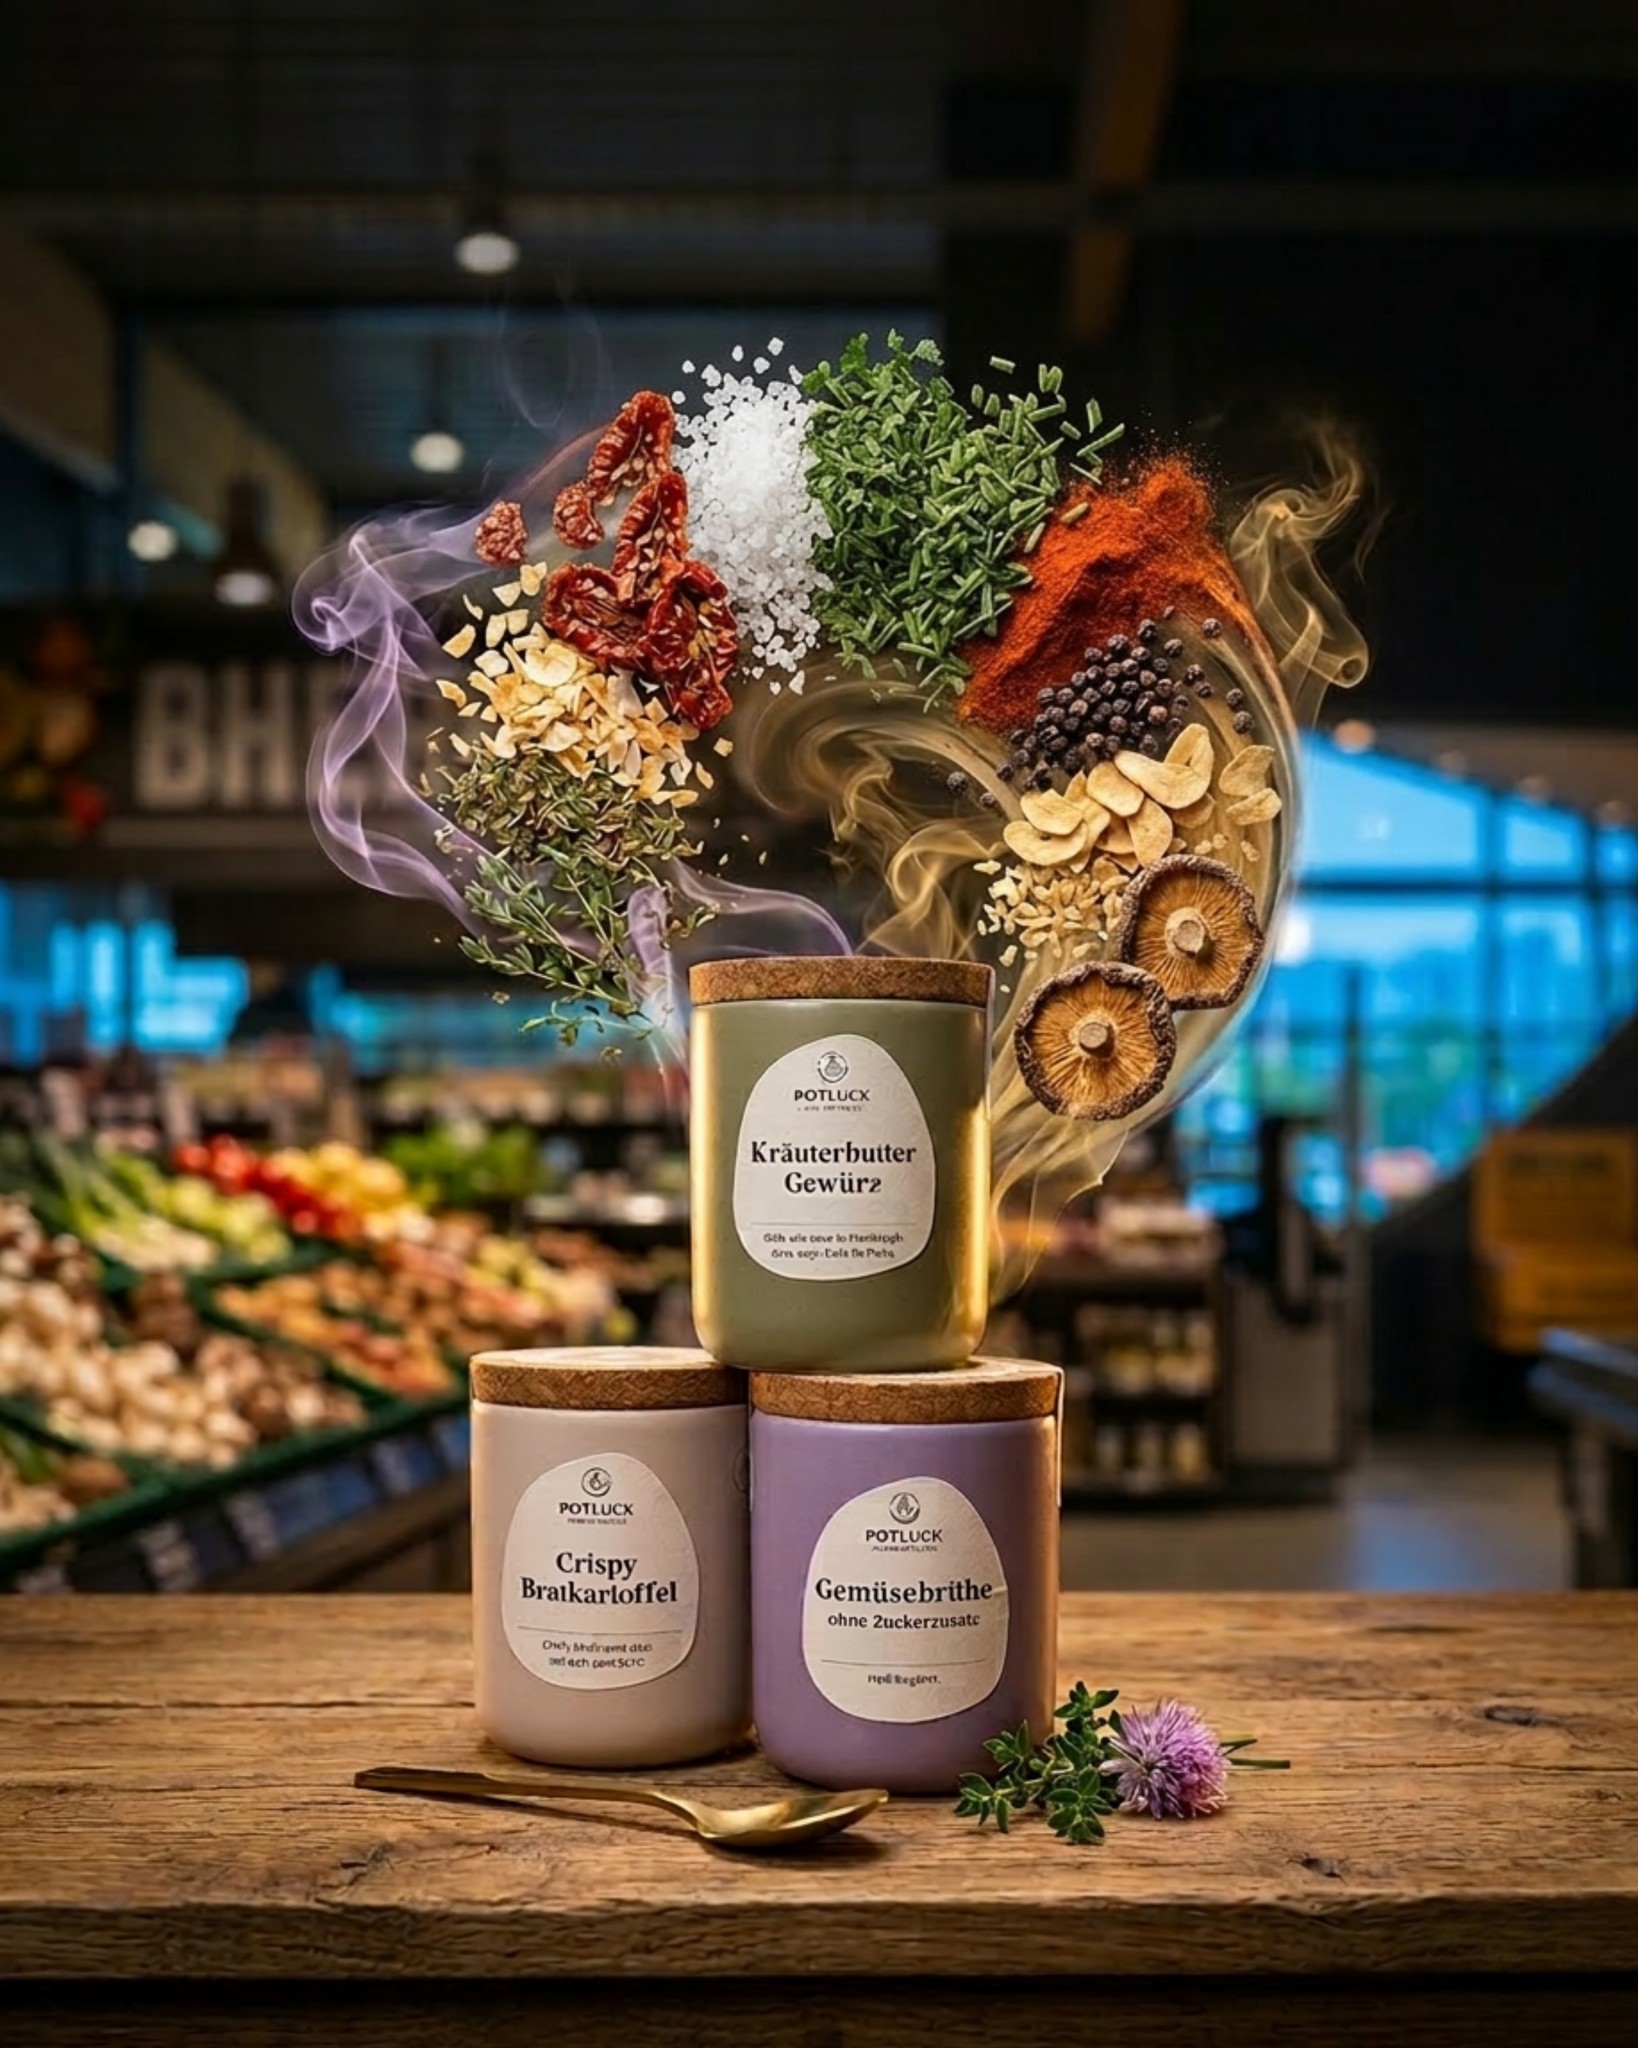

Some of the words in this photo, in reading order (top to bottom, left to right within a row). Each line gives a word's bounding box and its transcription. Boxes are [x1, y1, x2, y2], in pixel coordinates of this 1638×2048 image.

[751, 1141, 918, 1163] Kräuterbutter
[865, 1529, 943, 1543] POTLUCK
[555, 1551, 638, 1581] Crispy
[827, 1612, 868, 1628] ohne
